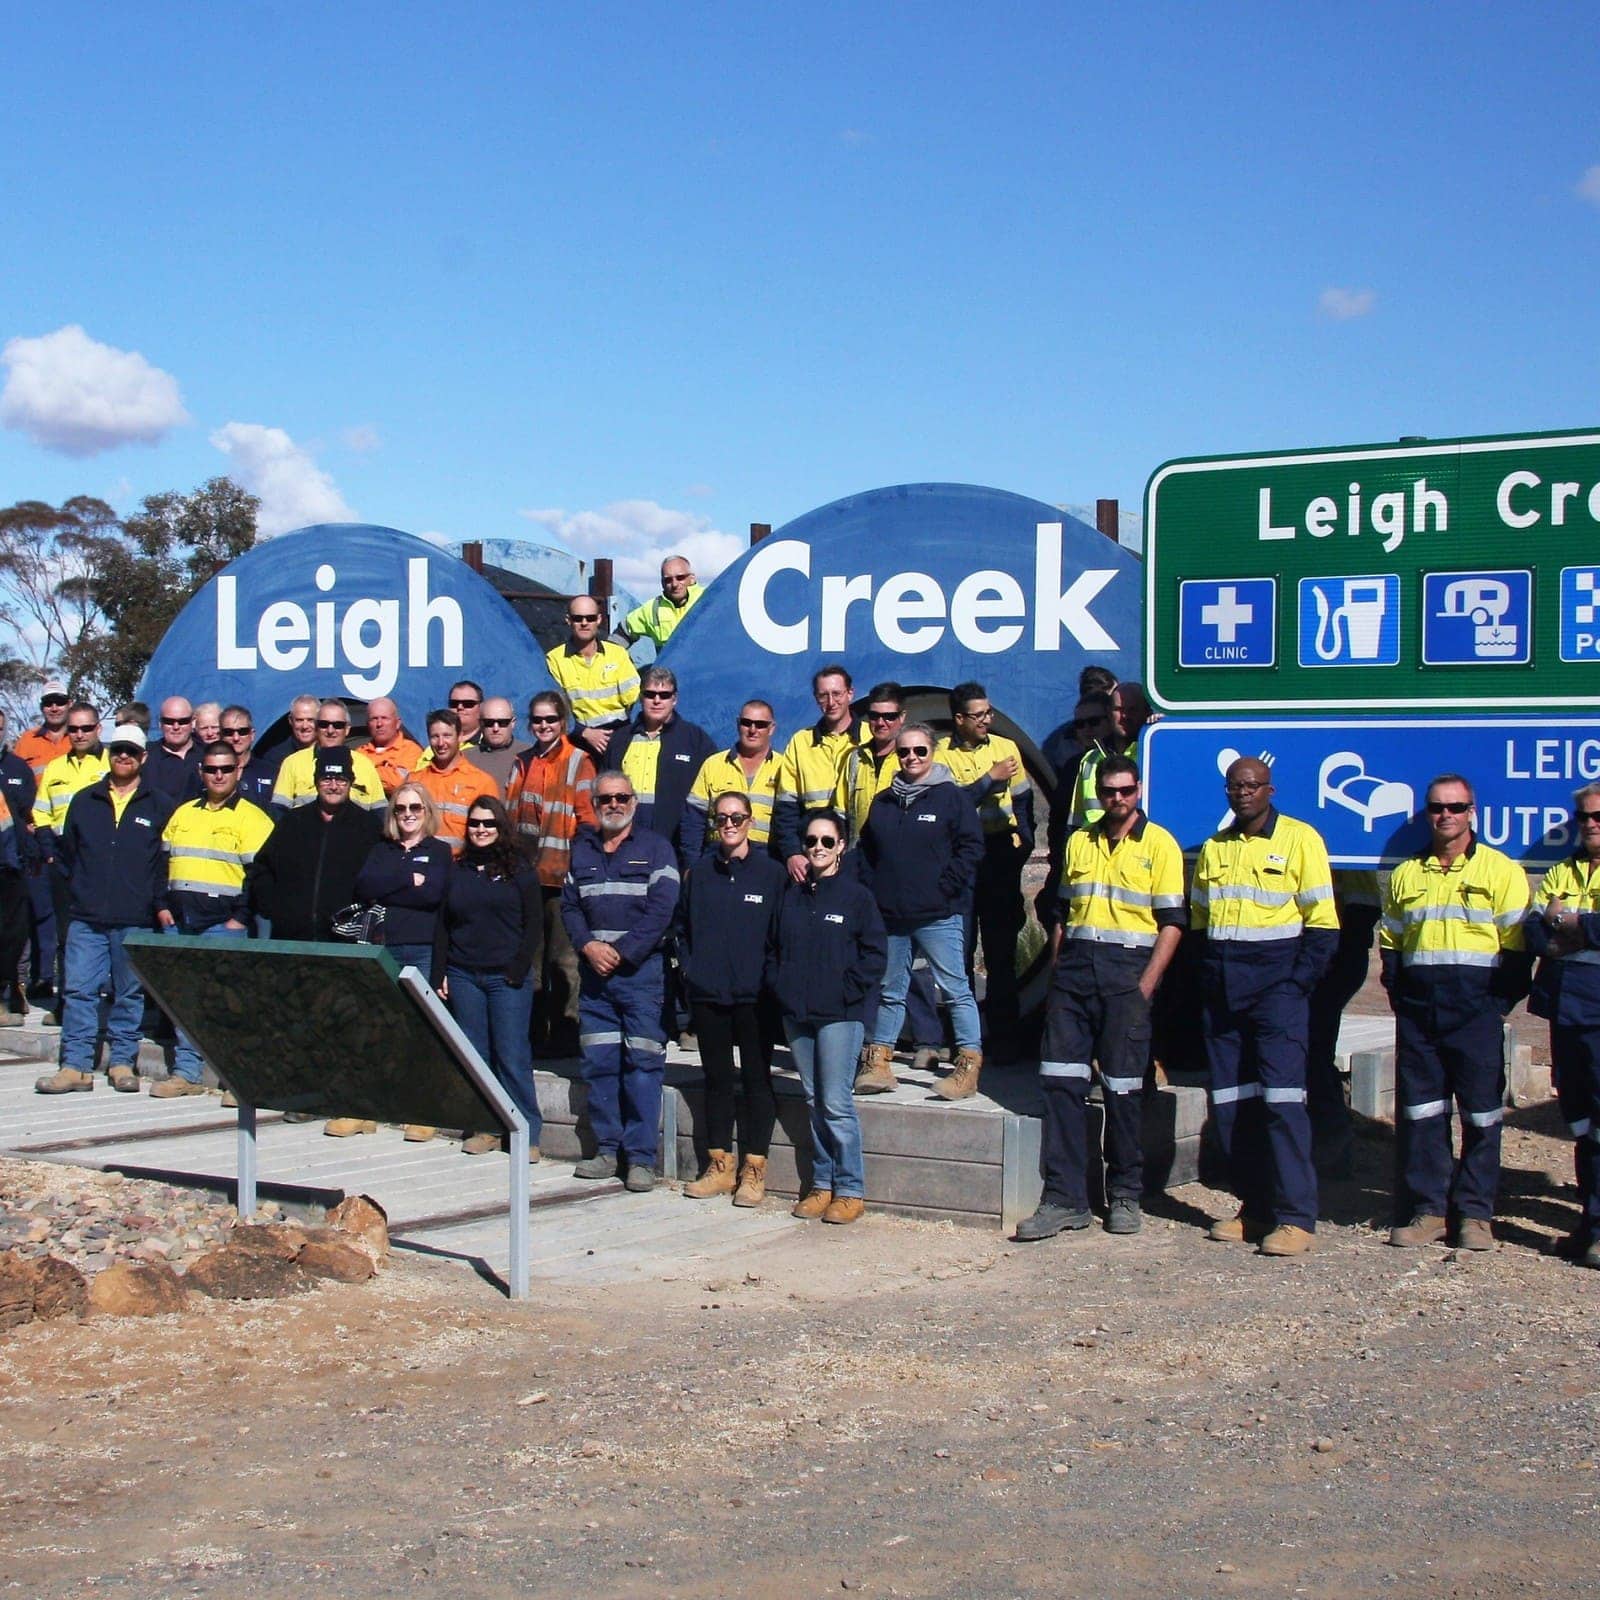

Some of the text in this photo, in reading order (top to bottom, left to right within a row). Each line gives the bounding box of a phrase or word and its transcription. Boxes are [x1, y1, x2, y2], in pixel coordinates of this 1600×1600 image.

[1258, 478, 1448, 553] Leigh
[216, 522, 1121, 700] Leigh Creek
[1204, 646, 1248, 660] CLINIC
[1506, 739, 1600, 780] LEIG
[1470, 806, 1582, 846] UTB
